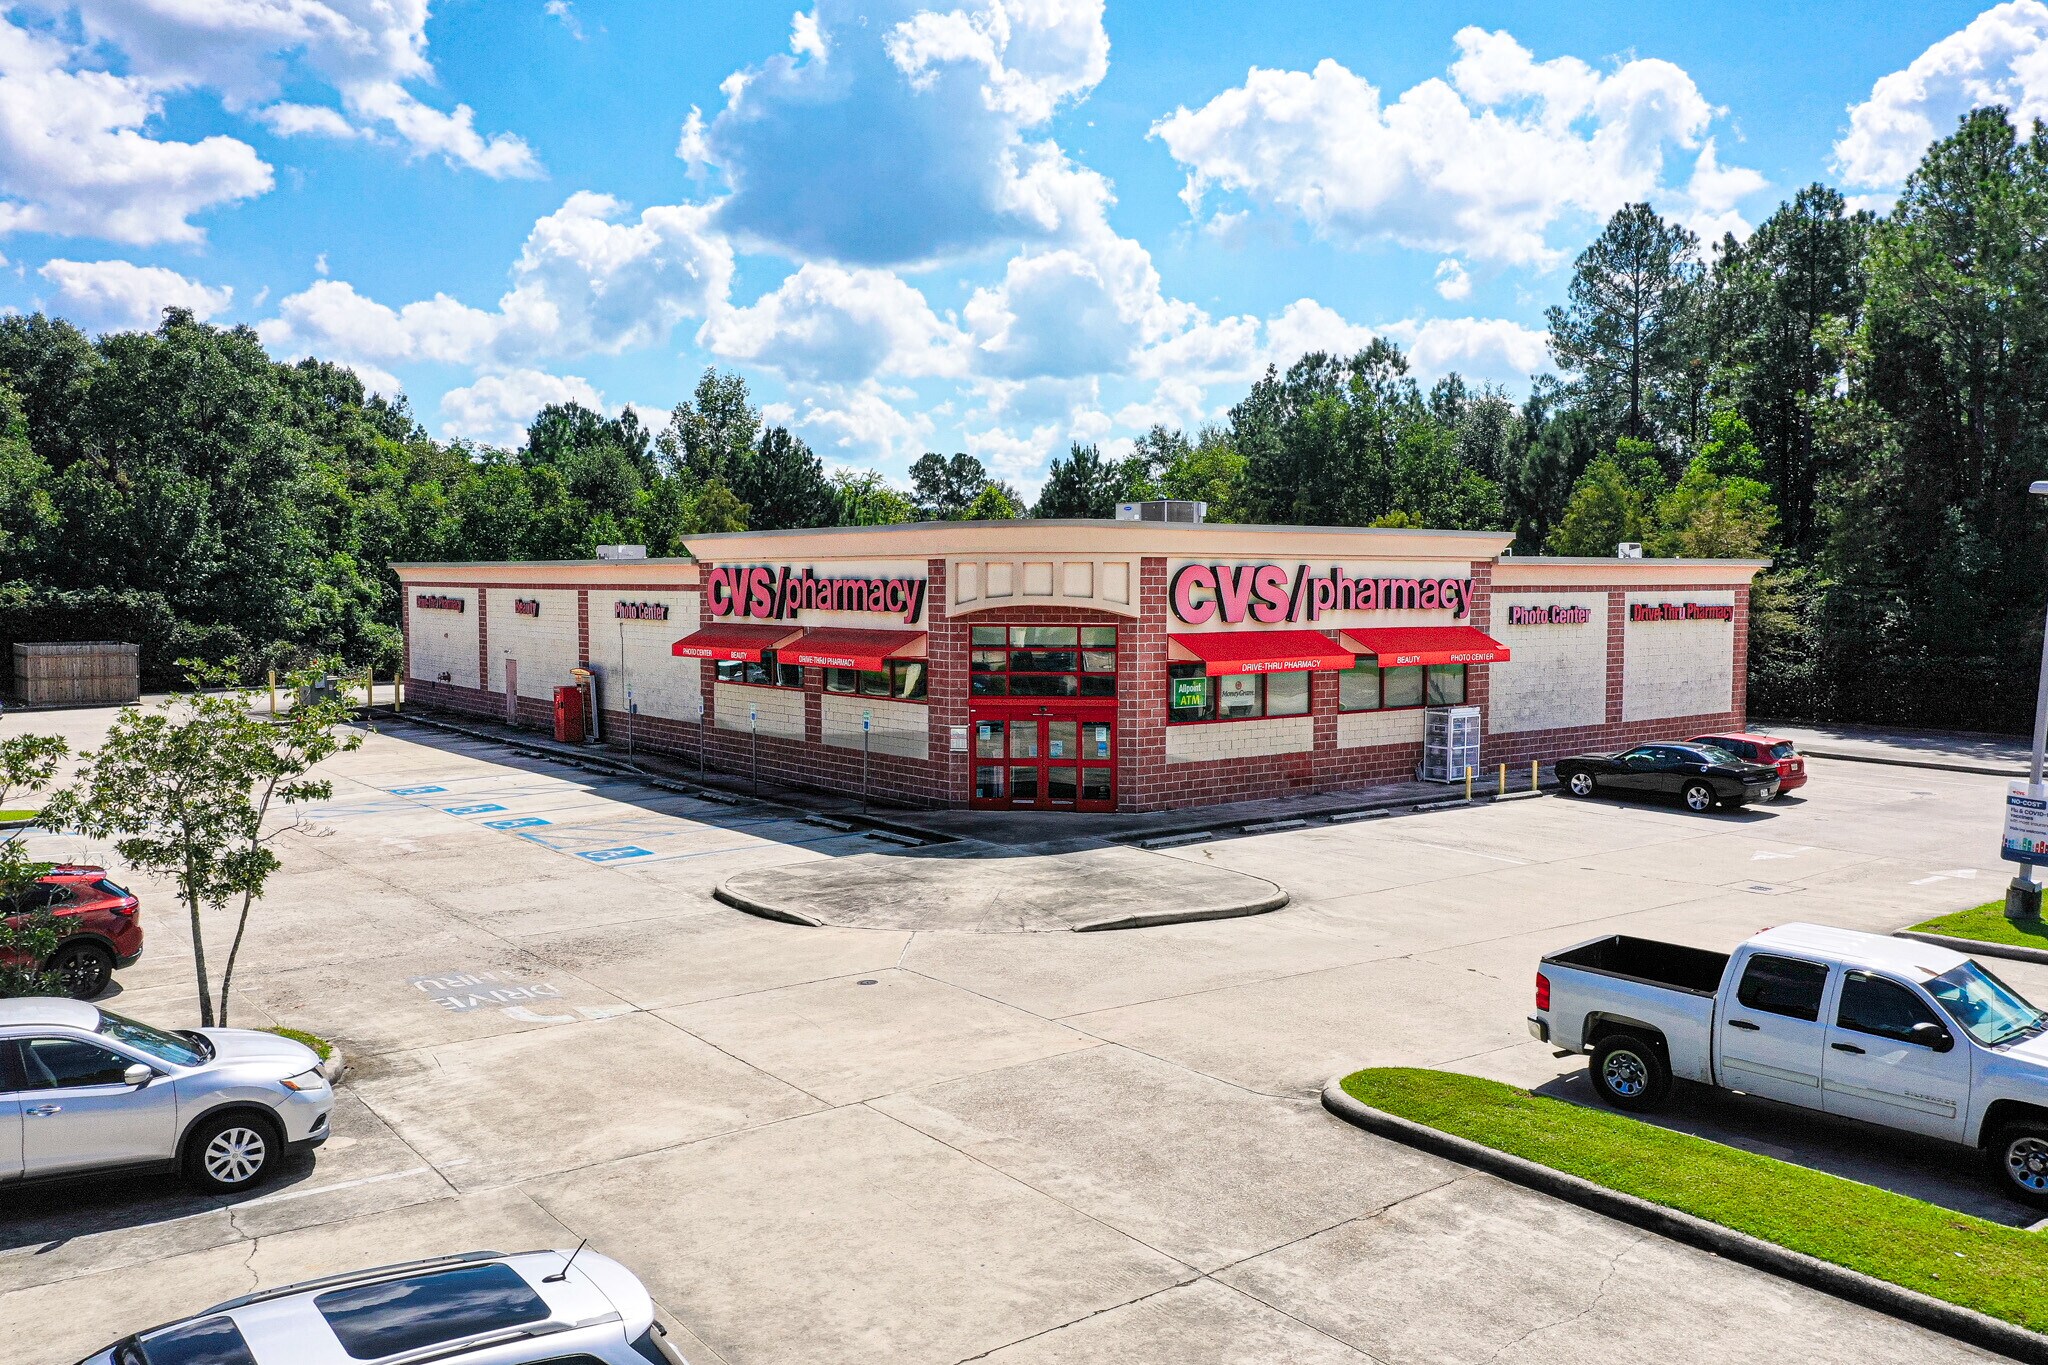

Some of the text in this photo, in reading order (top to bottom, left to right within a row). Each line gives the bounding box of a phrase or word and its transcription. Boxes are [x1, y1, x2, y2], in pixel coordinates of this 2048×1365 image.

[707, 566, 926, 624] CVS/pharmacy
[1170, 564, 1476, 624] CVS/pharmacy
[615, 601, 668, 620] Photo Center
[1509, 604, 1591, 624] Photo Center
[1631, 603, 1734, 622] Drive-Thru Pharmacy
[683, 647, 712, 657] PHOTO CENTER
[731, 651, 747, 659] BEAUTY
[1450, 652, 1494, 661] PHOTO CENTER
[827, 657, 855, 667] PHARMACY
[1396, 655, 1420, 664] BEAUTY
[1242, 660, 1321, 671] DRIVE-THRU PHARMACY
[1178, 682, 1201, 694] Allpoint
[1180, 694, 1200, 705] ATM
[430, 981, 560, 1011] DRIVE
